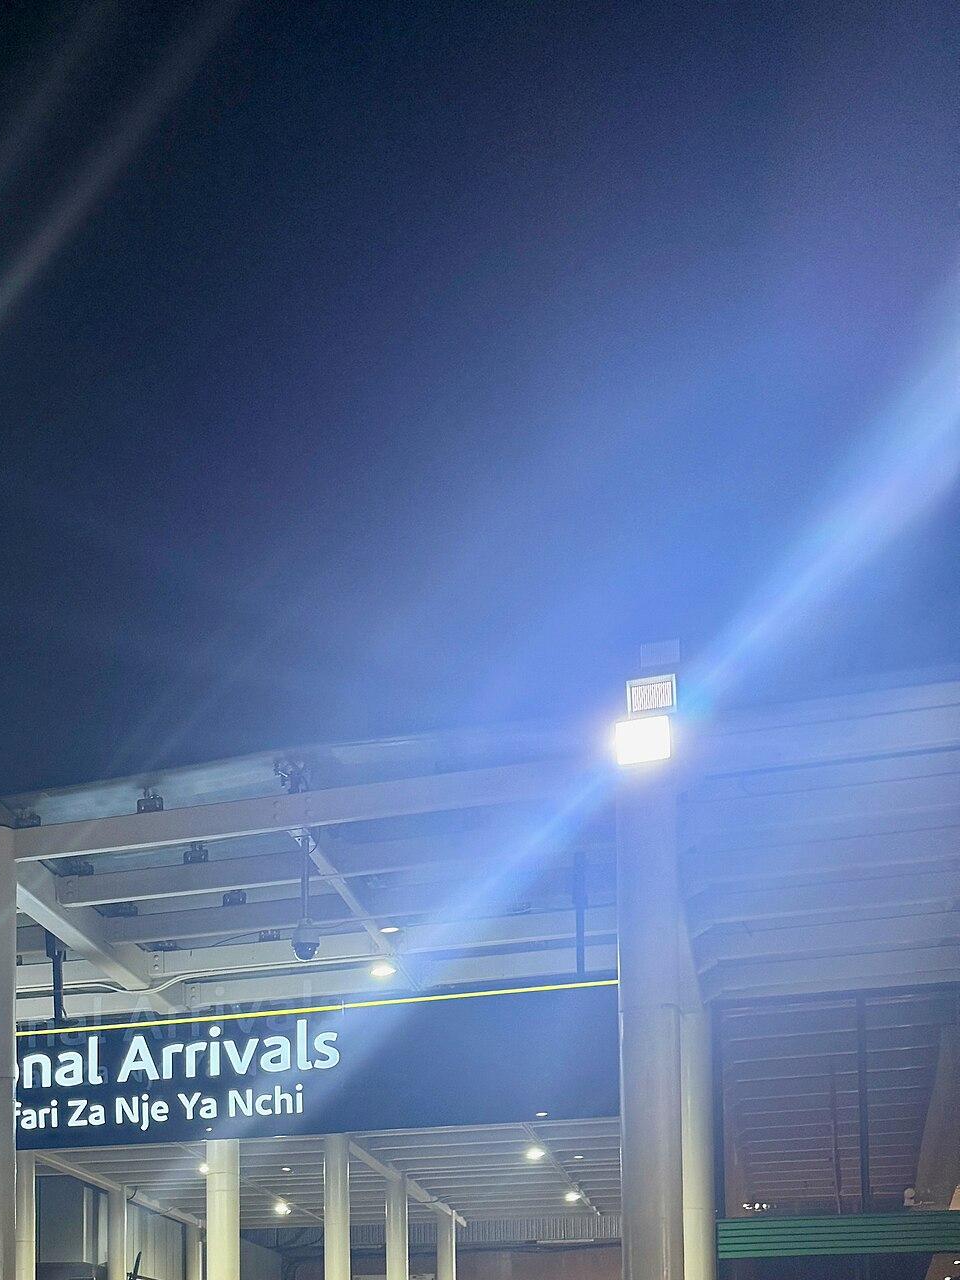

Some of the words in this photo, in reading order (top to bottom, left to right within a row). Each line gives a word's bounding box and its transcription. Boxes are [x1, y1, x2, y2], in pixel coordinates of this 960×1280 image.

[117, 1018, 340, 1083] Arrivals
[14, 1099, 58, 1130] fari
[67, 1099, 106, 1127] Za
[115, 1093, 169, 1131] Nje
[177, 1091, 217, 1120] Ya
[228, 1083, 303, 1118] Nchi
